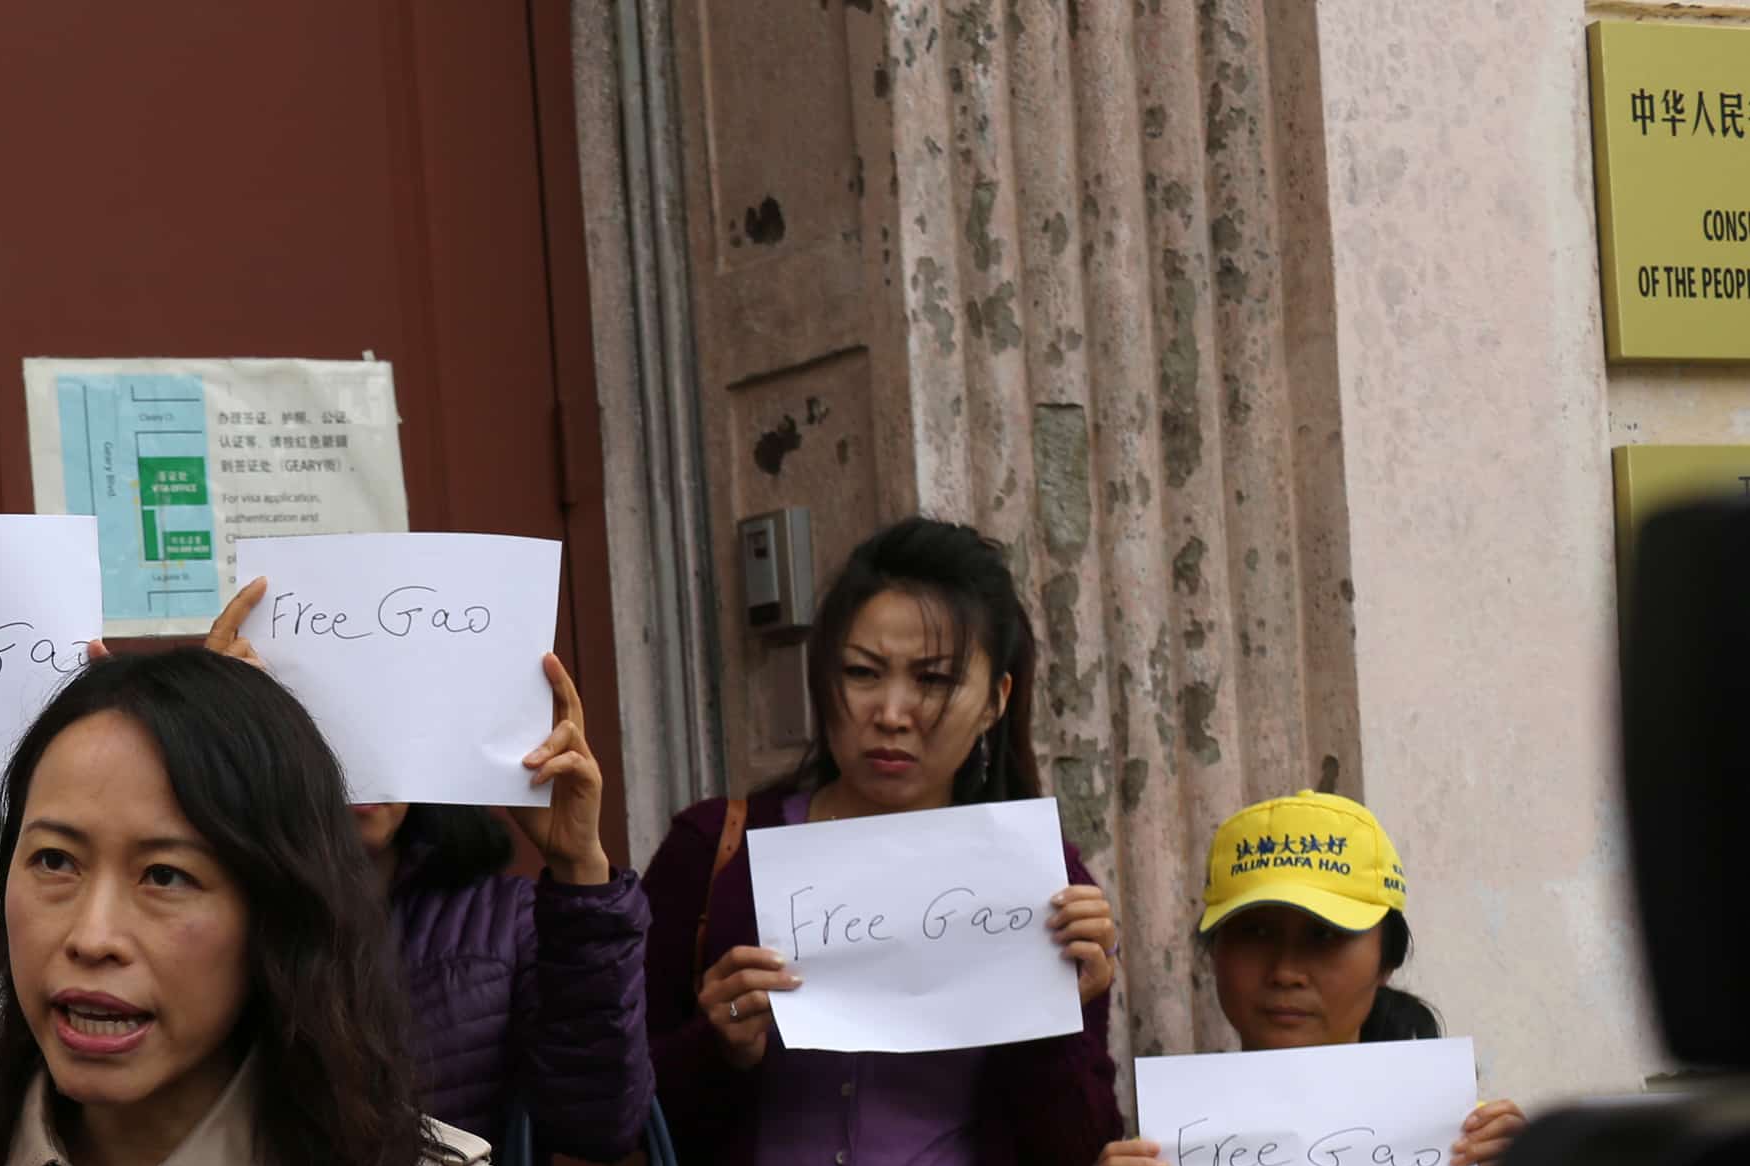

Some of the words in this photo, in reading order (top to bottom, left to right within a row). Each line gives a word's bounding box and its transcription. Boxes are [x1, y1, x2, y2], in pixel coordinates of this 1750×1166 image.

[1631, 88, 1750, 138] 中华人民
[1703, 209, 1750, 241] CONS
[1639, 266, 1659, 297] OF
[1664, 266, 1697, 298] THE
[272, 592, 374, 640] Free
[378, 585, 491, 637] Gao
[1231, 857, 1270, 877] FALUN
[1273, 855, 1313, 870] DAFA
[1318, 859, 1351, 876] HAO
[790, 885, 893, 961] Free
[922, 887, 1034, 940] Gao
